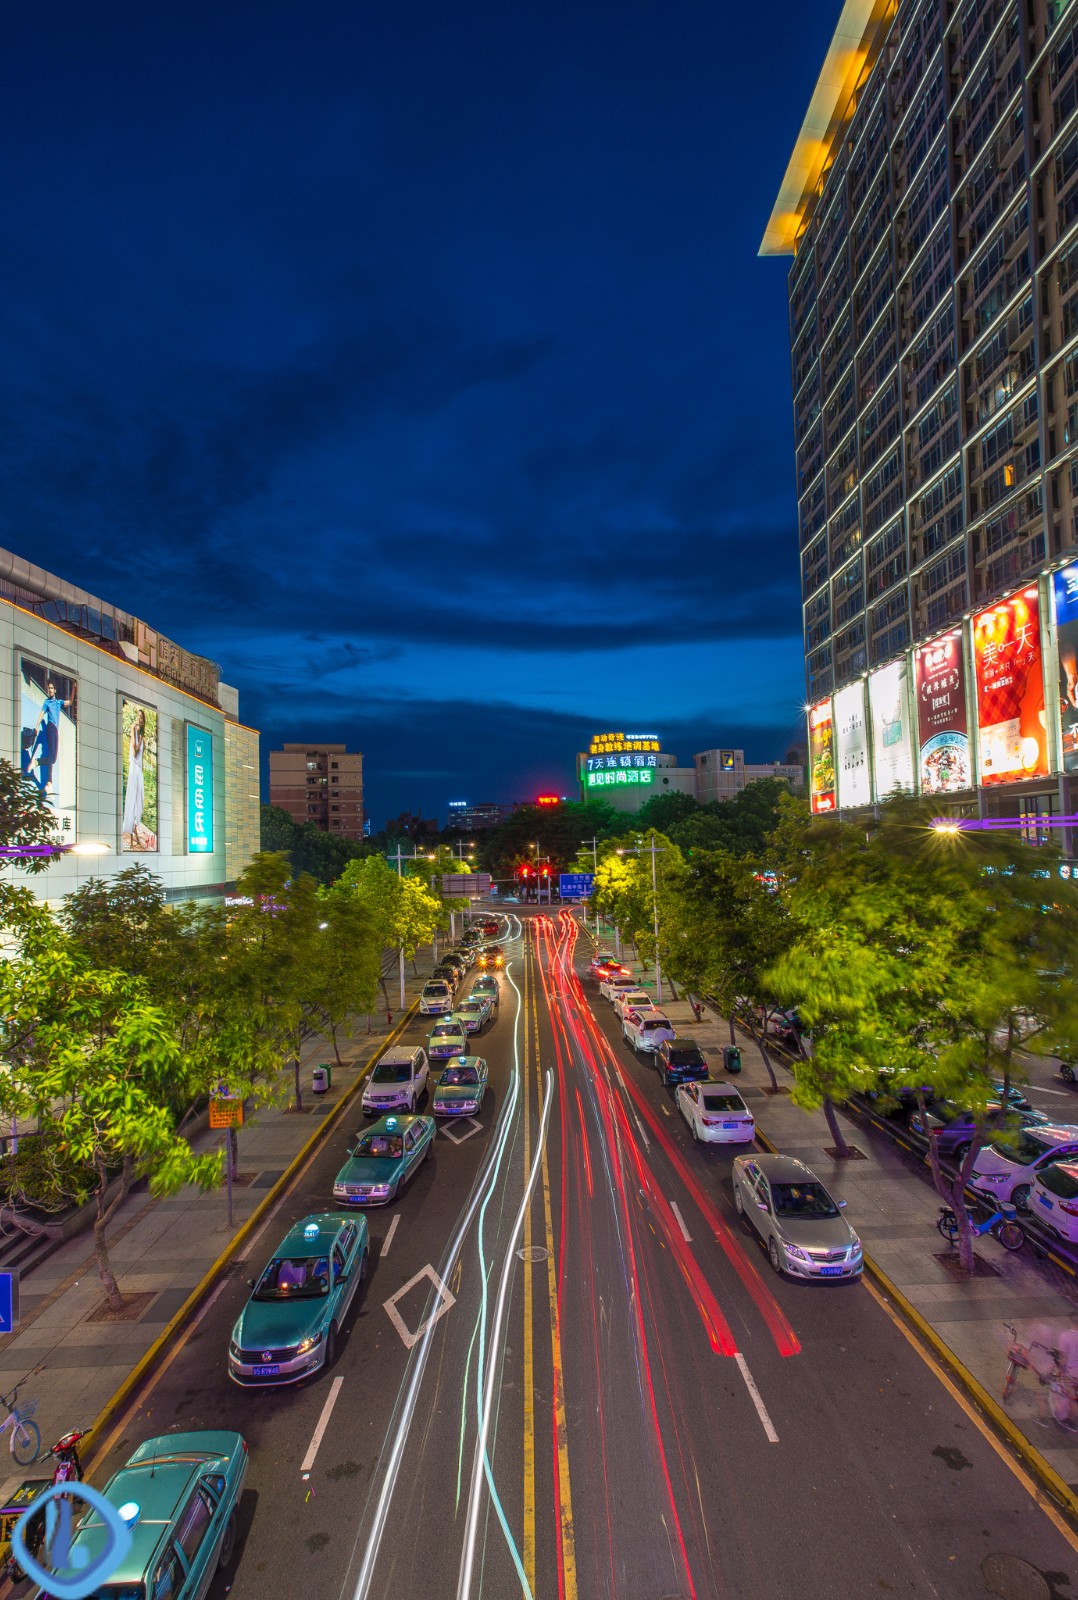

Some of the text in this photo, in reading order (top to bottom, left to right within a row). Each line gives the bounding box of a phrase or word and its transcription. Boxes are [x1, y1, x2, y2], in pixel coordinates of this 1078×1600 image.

[587, 756, 656, 771] 7天连锁酒店
